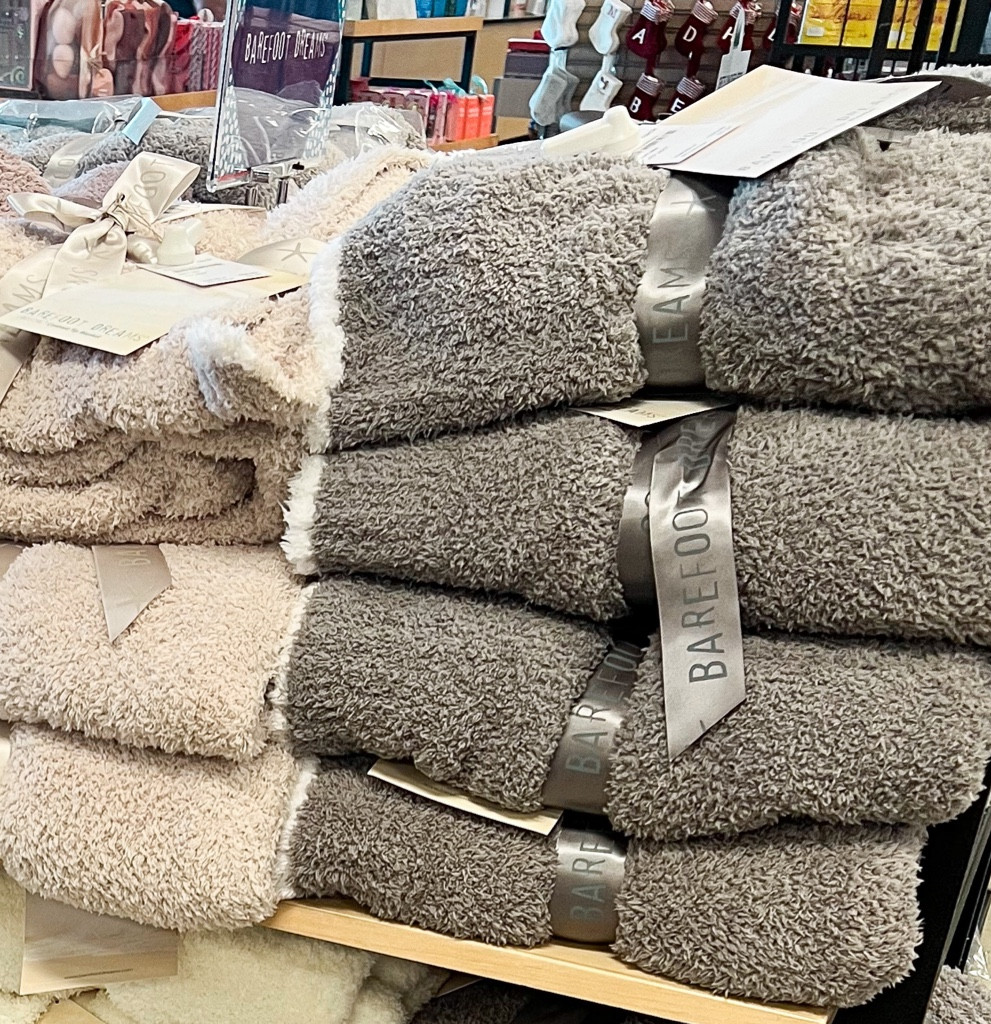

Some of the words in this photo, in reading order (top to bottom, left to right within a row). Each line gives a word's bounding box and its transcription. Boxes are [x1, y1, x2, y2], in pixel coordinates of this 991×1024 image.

[632, 28, 646, 45] A
[683, 26, 698, 42] D
[245, 31, 292, 65] BAREFOOT
[294, 29, 326, 60] DREAMS
[630, 98, 642, 113] B
[672, 491, 728, 684] BAREFOO
